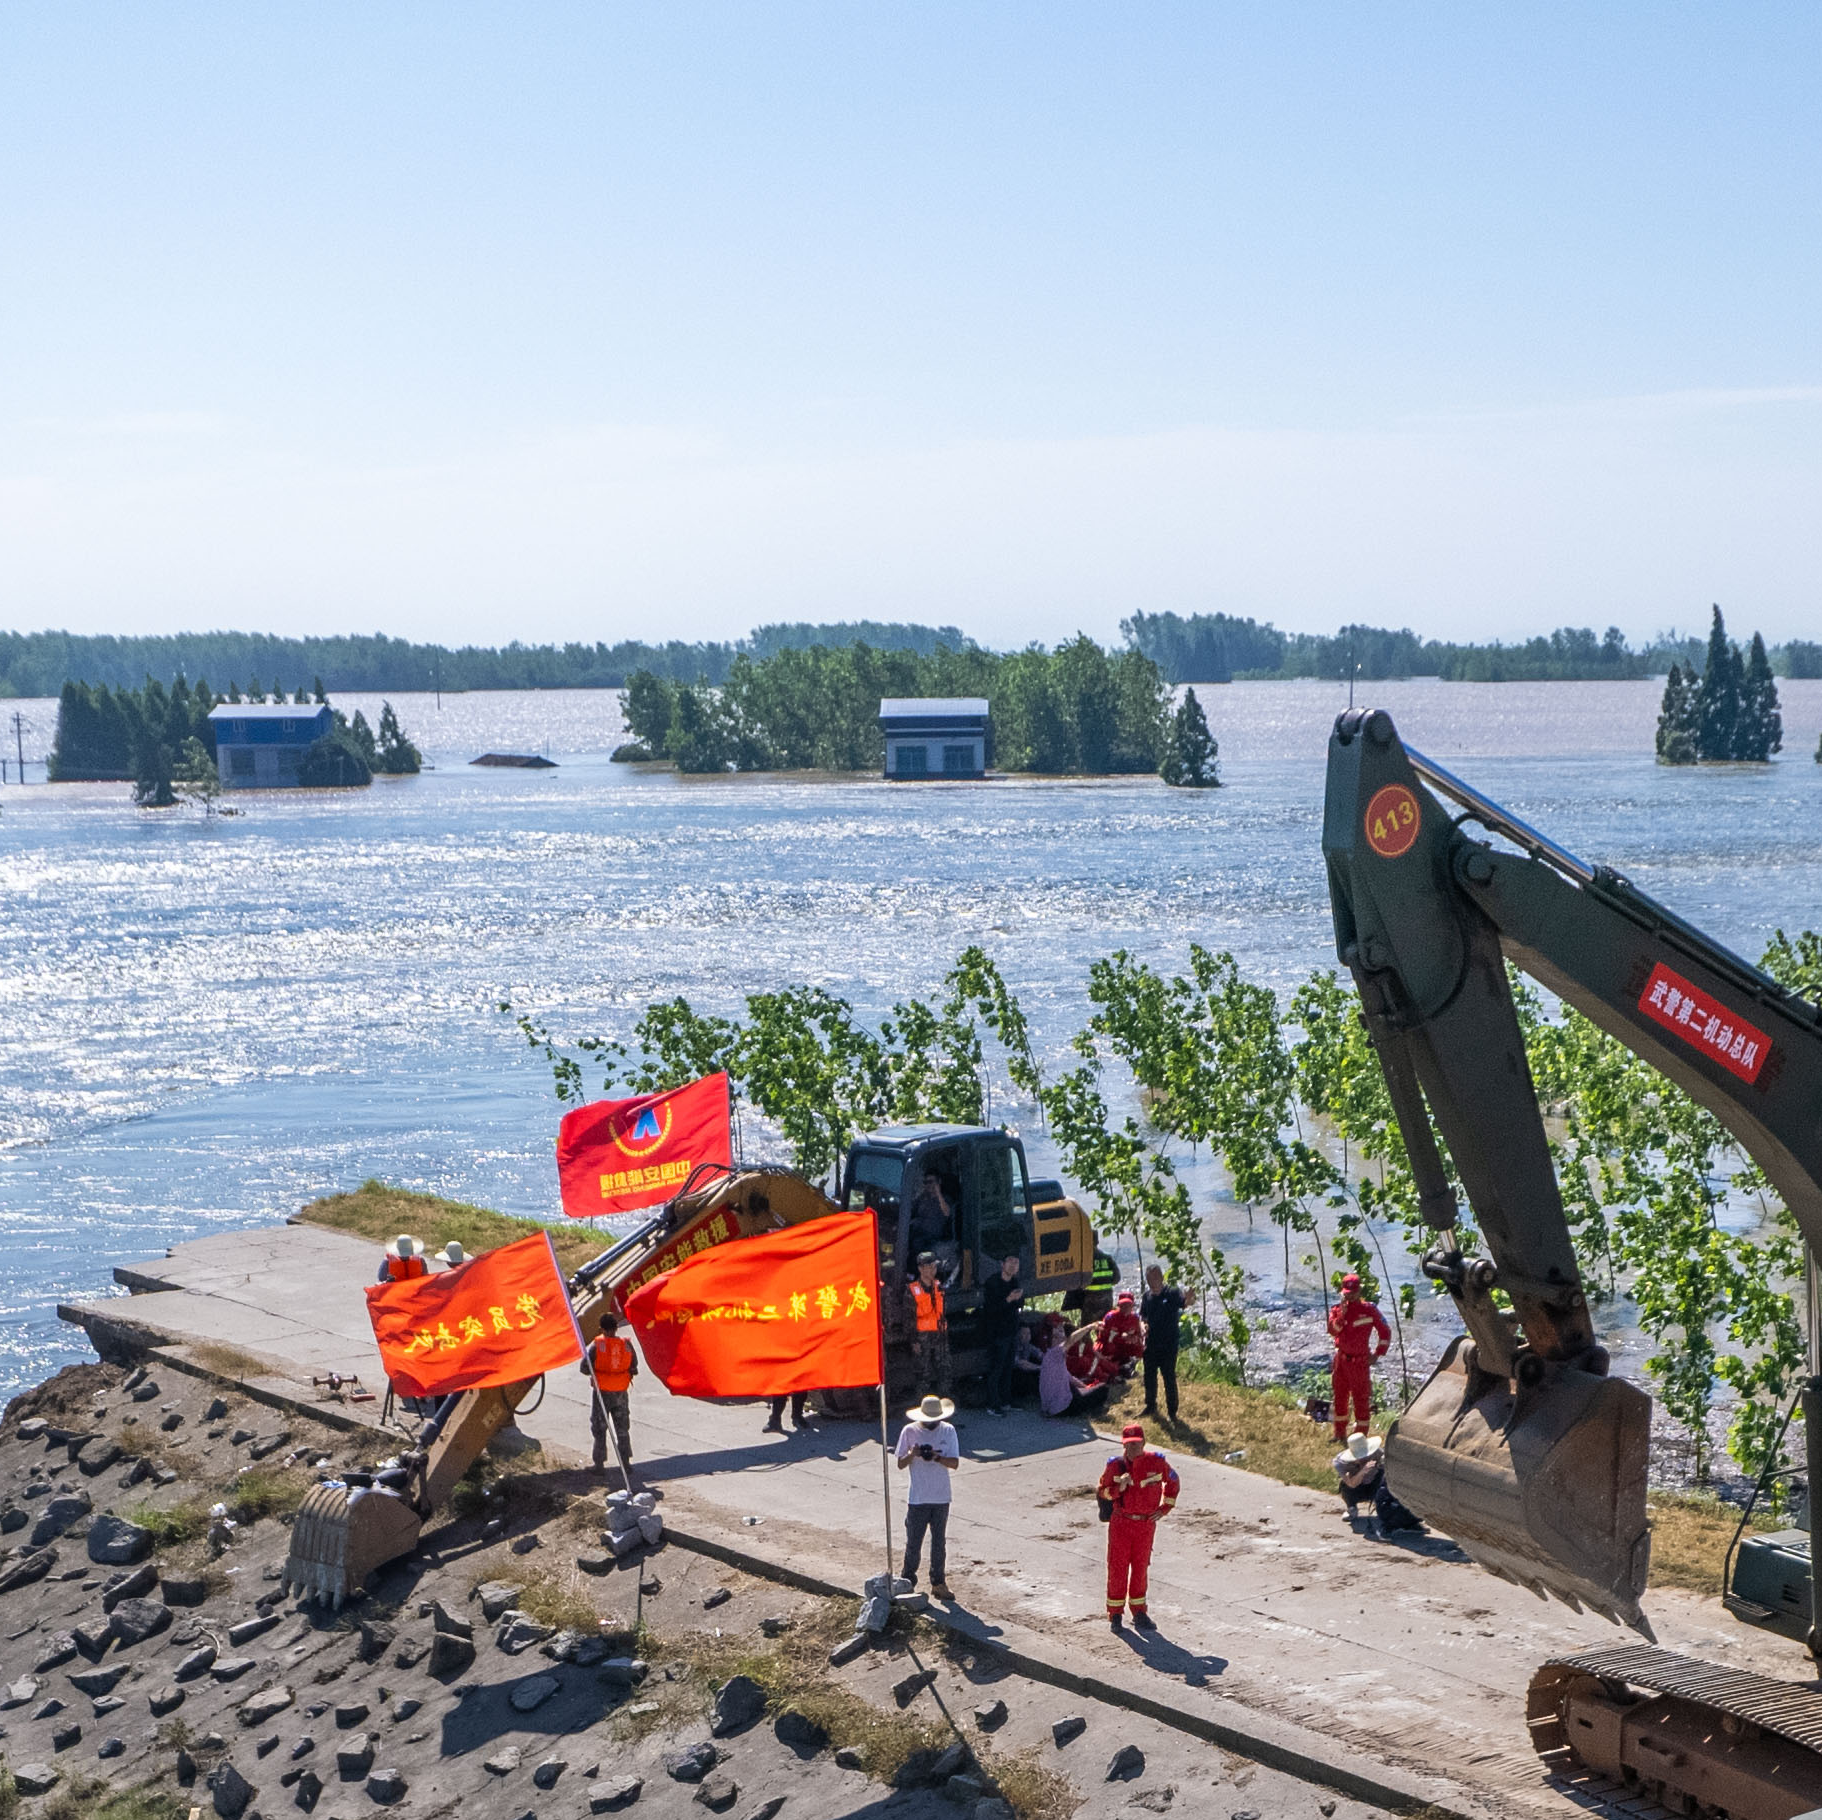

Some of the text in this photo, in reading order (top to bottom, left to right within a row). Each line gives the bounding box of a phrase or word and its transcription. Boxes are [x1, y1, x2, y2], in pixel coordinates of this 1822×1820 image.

[1374, 801, 1414, 840] 413
[1648, 980, 1759, 1070] 武警第二机动总队
